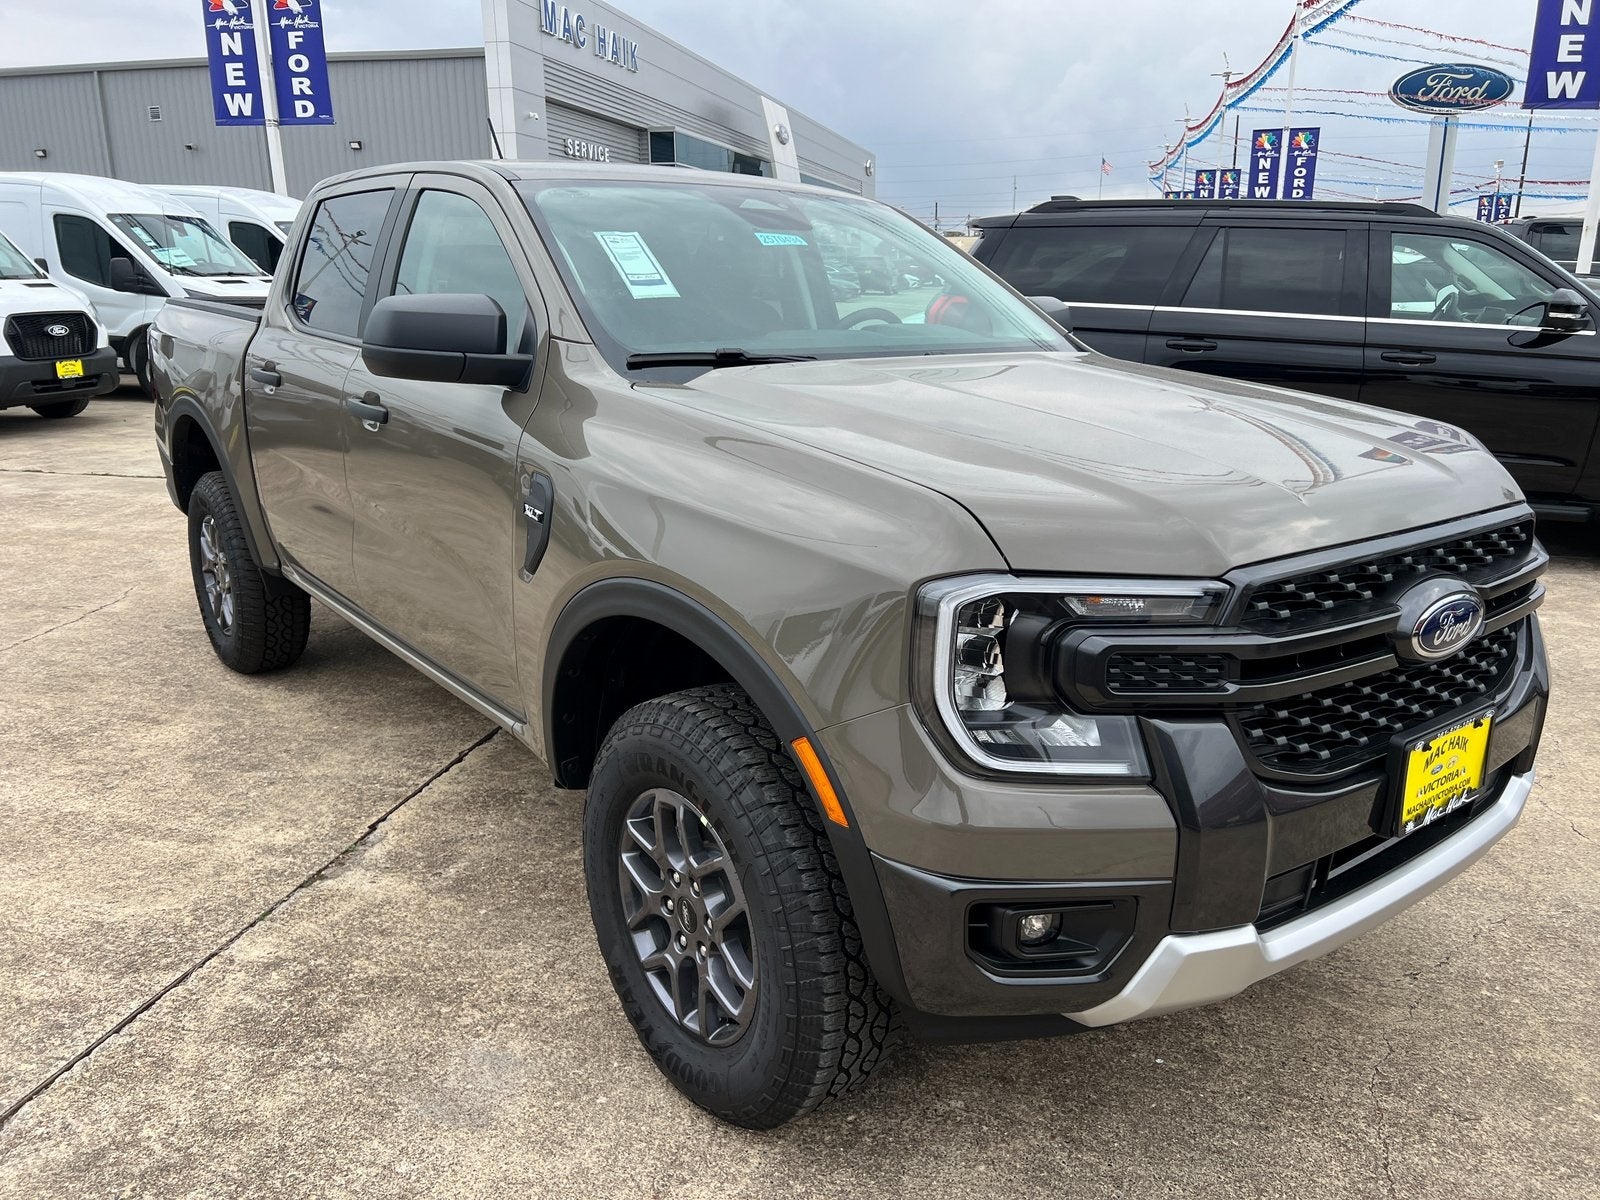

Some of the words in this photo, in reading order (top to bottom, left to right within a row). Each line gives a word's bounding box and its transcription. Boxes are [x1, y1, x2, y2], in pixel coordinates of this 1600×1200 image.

[541, 0, 586, 48] MAC
[594, 24, 639, 73] HAIK
[1546, 0, 1592, 99] NEW
[220, 32, 252, 117] NEW
[287, 31, 315, 118] FORD
[1418, 73, 1491, 101] Ford
[567, 138, 610, 163] SERVICE
[1254, 158, 1271, 198] NEW
[1292, 157, 1307, 198] FORD
[524, 503, 543, 521] XLT
[1434, 607, 1473, 645] Ford
[1423, 740, 1448, 773] MAC
[1448, 736, 1469, 752] HAIK
[1423, 769, 1459, 796] VICTORIA
[1423, 805, 1446, 826] Mac
